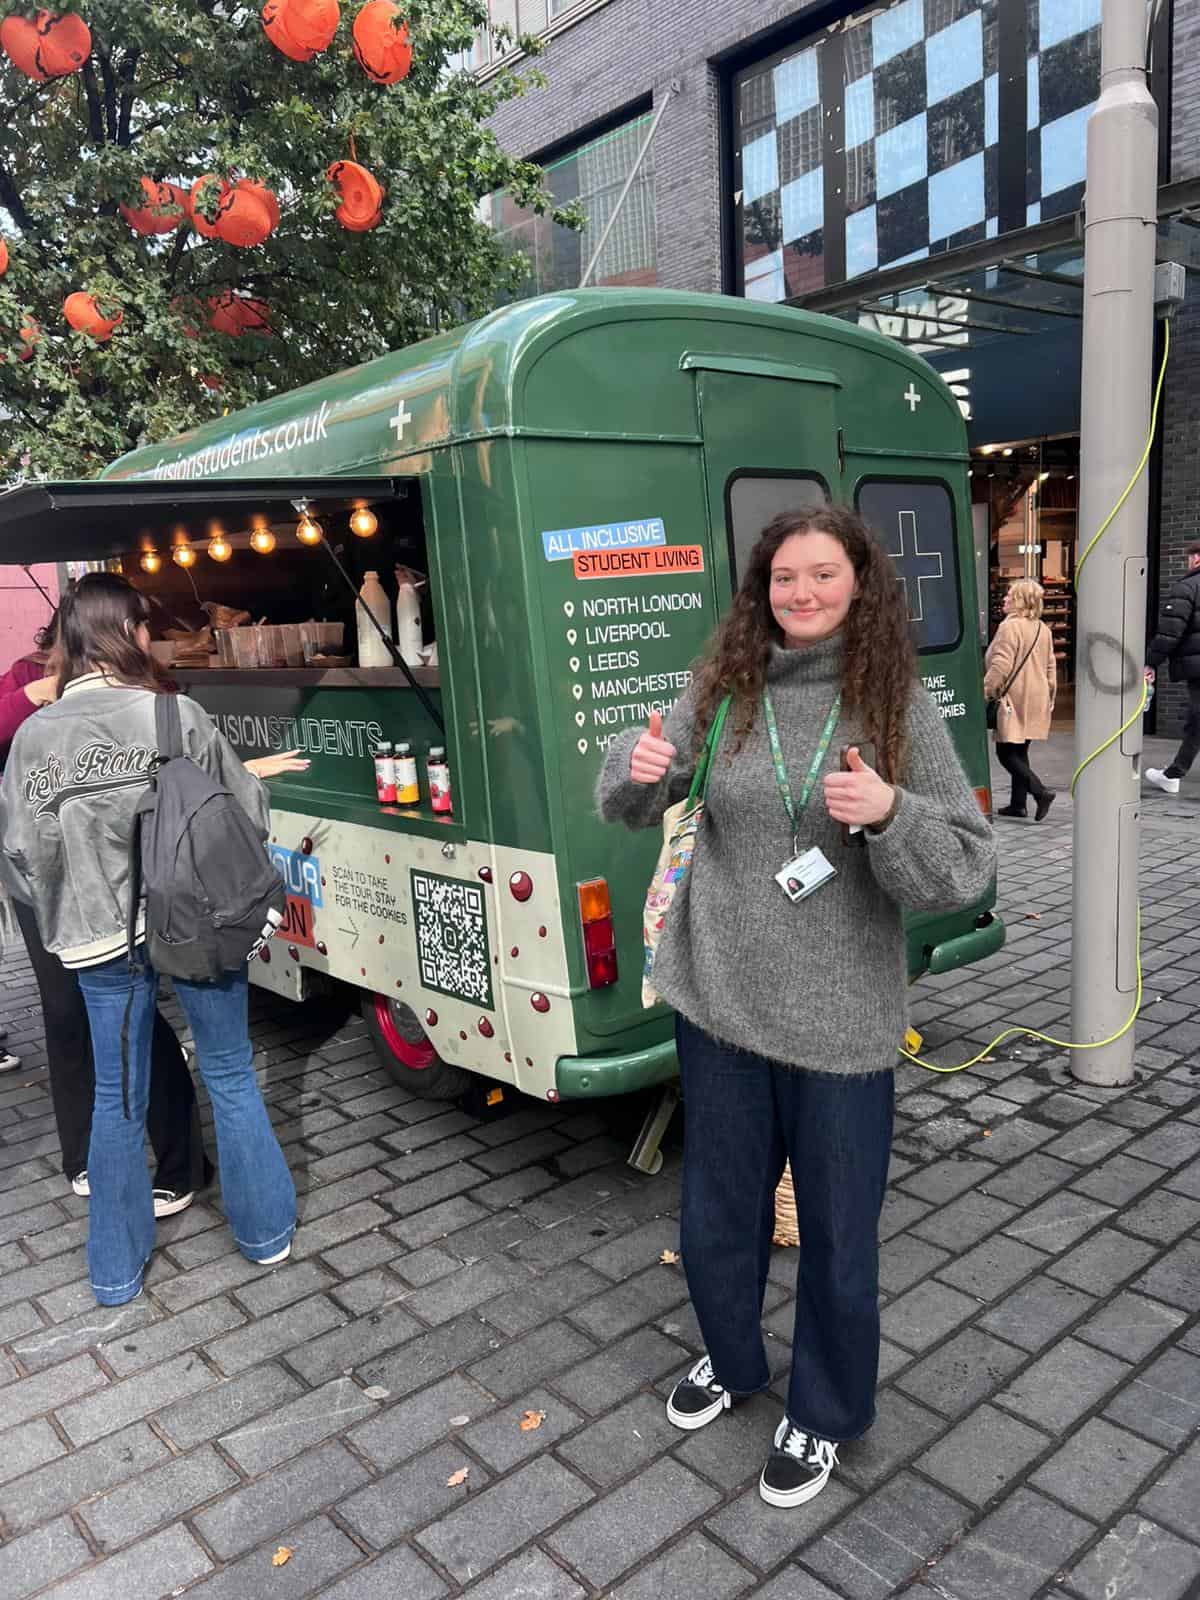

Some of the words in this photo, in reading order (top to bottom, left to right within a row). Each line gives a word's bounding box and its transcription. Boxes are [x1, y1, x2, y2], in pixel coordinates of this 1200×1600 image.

[549, 535, 577, 553] ALL
[583, 522, 661, 549] INCLUSIVE
[578, 552, 650, 573] STUDENT
[655, 549, 700, 568] LIVING
[583, 597, 638, 617] NORTH
[642, 592, 702, 613] LONDON
[585, 622, 671, 645] LIVERPOOL
[588, 650, 640, 672] LEEDS
[591, 671, 694, 699] MANCHESTER
[921, 674, 946, 689] TAKE
[593, 698, 678, 726] NOTTINGH
[937, 703, 967, 719] OKIES
[268, 845, 320, 900] OUR
[332, 865, 354, 881] SCAN
[355, 871, 366, 885] TO
[367, 874, 388, 890] TAKE
[334, 879, 350, 894] THE
[375, 890, 396, 906] STAY
[335, 894, 351, 908] FOR
[352, 898, 369, 914] THE
[370, 903, 408, 925] COOKIES
